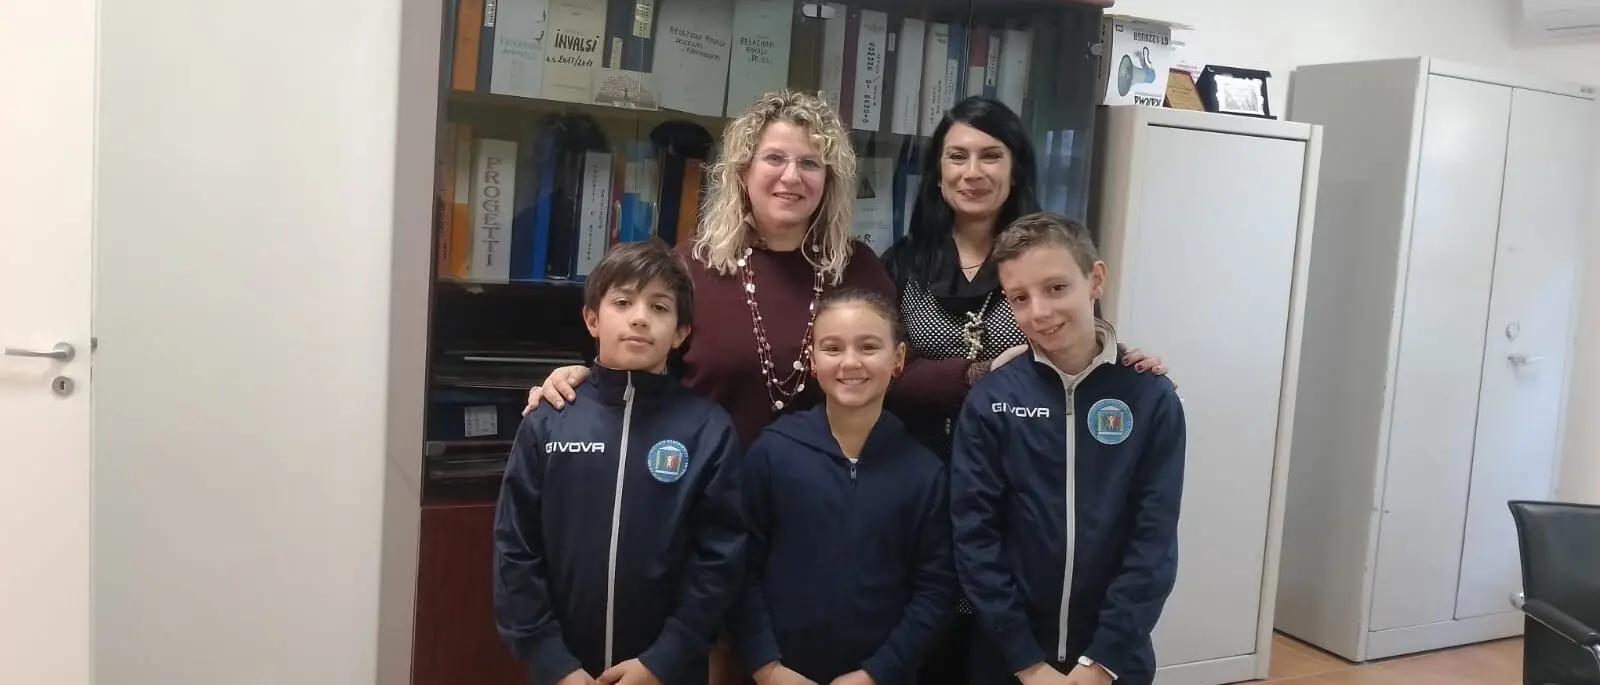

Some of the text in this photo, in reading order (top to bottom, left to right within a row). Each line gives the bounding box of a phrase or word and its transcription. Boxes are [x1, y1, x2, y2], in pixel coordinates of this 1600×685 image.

[480, 156, 503, 267] PROGETTI
[991, 402, 1050, 418] GIVOVA
[545, 441, 605, 454] GIVOVA
